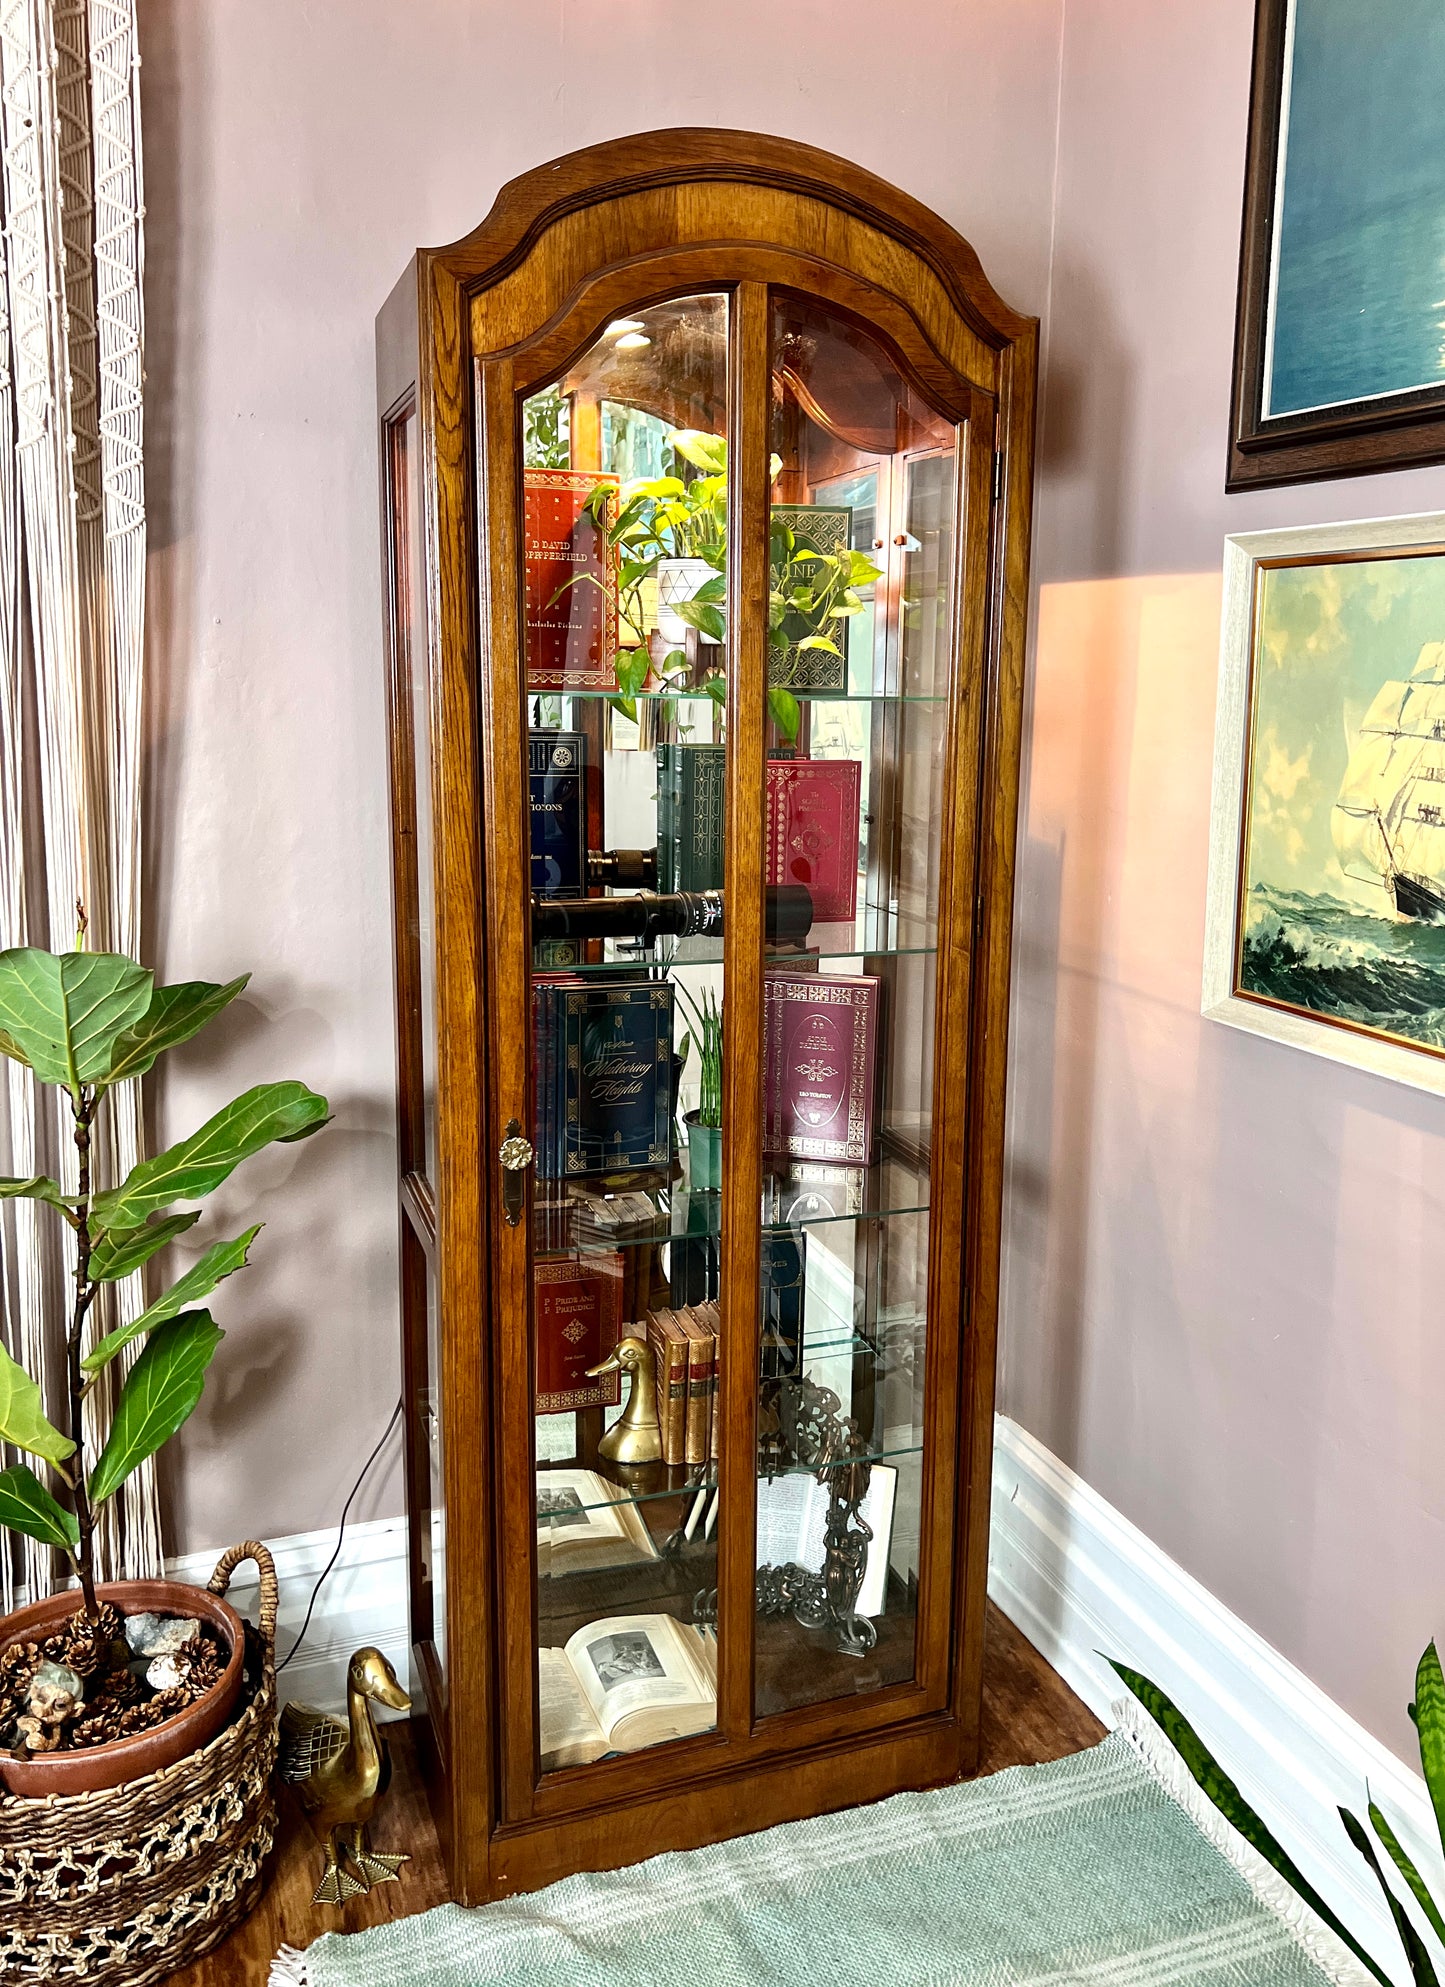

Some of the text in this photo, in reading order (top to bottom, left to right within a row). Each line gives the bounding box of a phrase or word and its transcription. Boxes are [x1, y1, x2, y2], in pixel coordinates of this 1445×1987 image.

[541, 541, 571, 550] DAVID
[583, 1057, 653, 1079] Wuthering
[590, 1079, 644, 1101] Heights
[555, 1297, 578, 1306] PRIDE
[579, 1295, 596, 1303] AND
[555, 1303, 596, 1314] PREJUDICE
